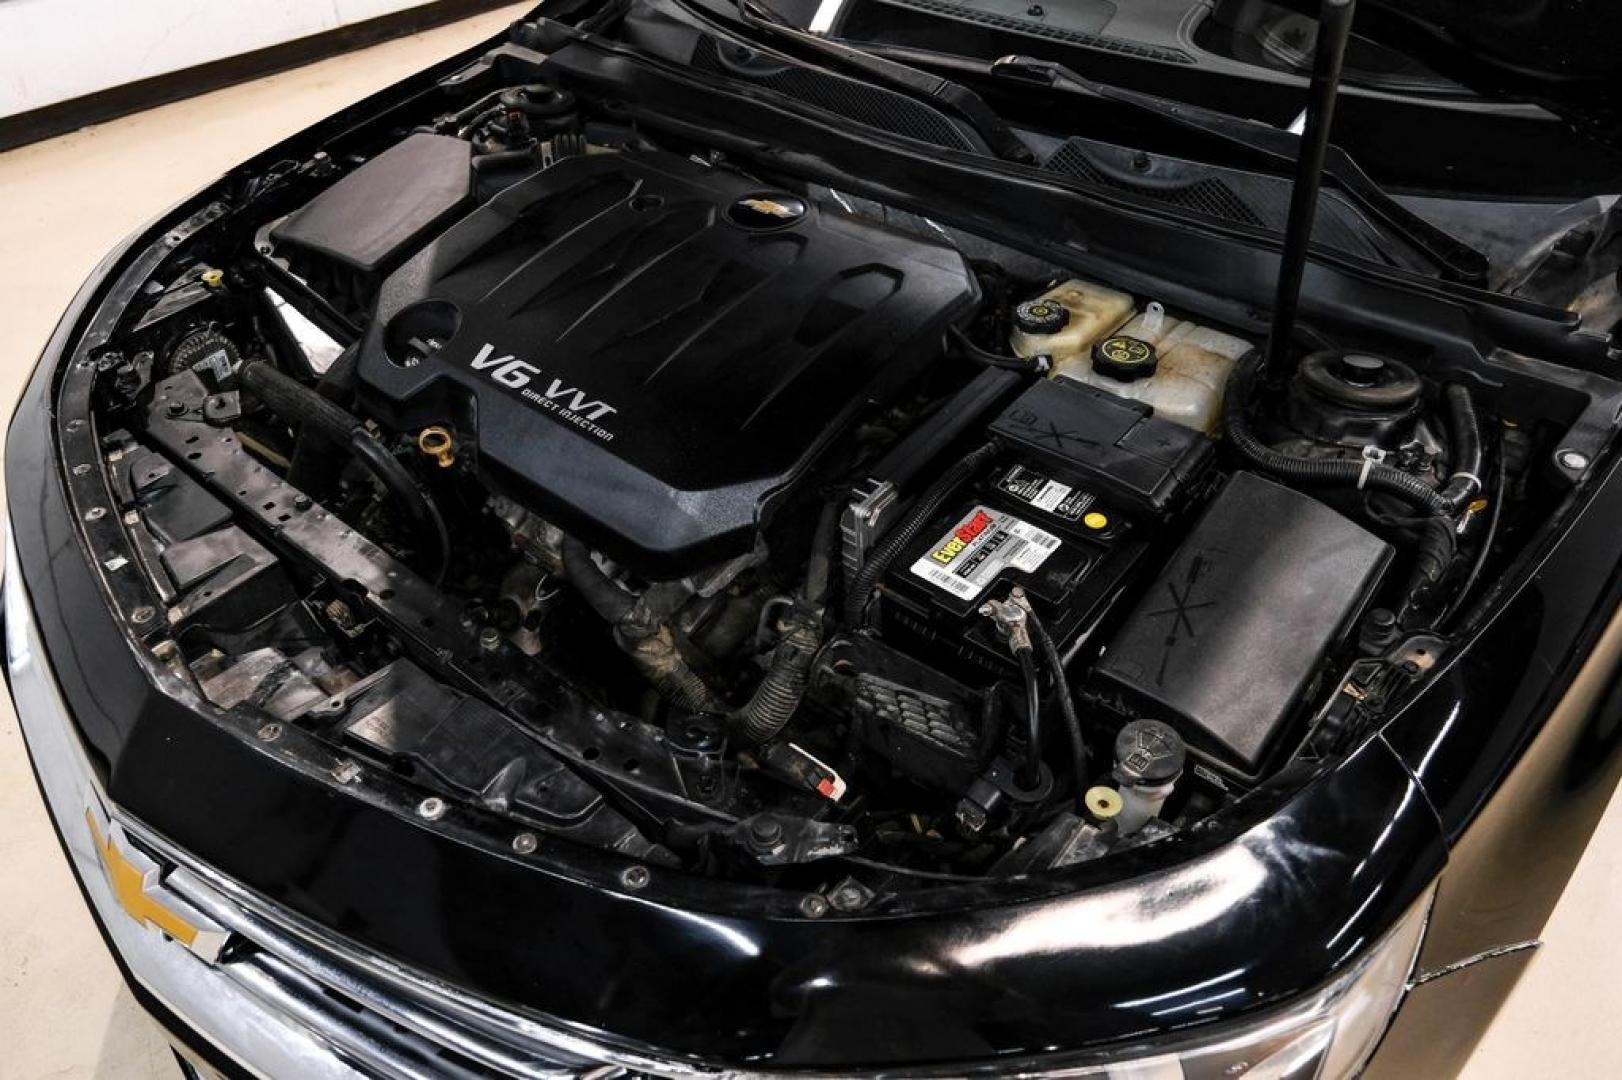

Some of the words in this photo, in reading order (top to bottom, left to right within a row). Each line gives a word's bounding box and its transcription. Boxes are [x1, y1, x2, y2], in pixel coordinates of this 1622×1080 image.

[470, 343, 541, 388] V6
[545, 378, 618, 421] VVT
[520, 388, 560, 411] DIRECT
[932, 510, 993, 564] EverStart
